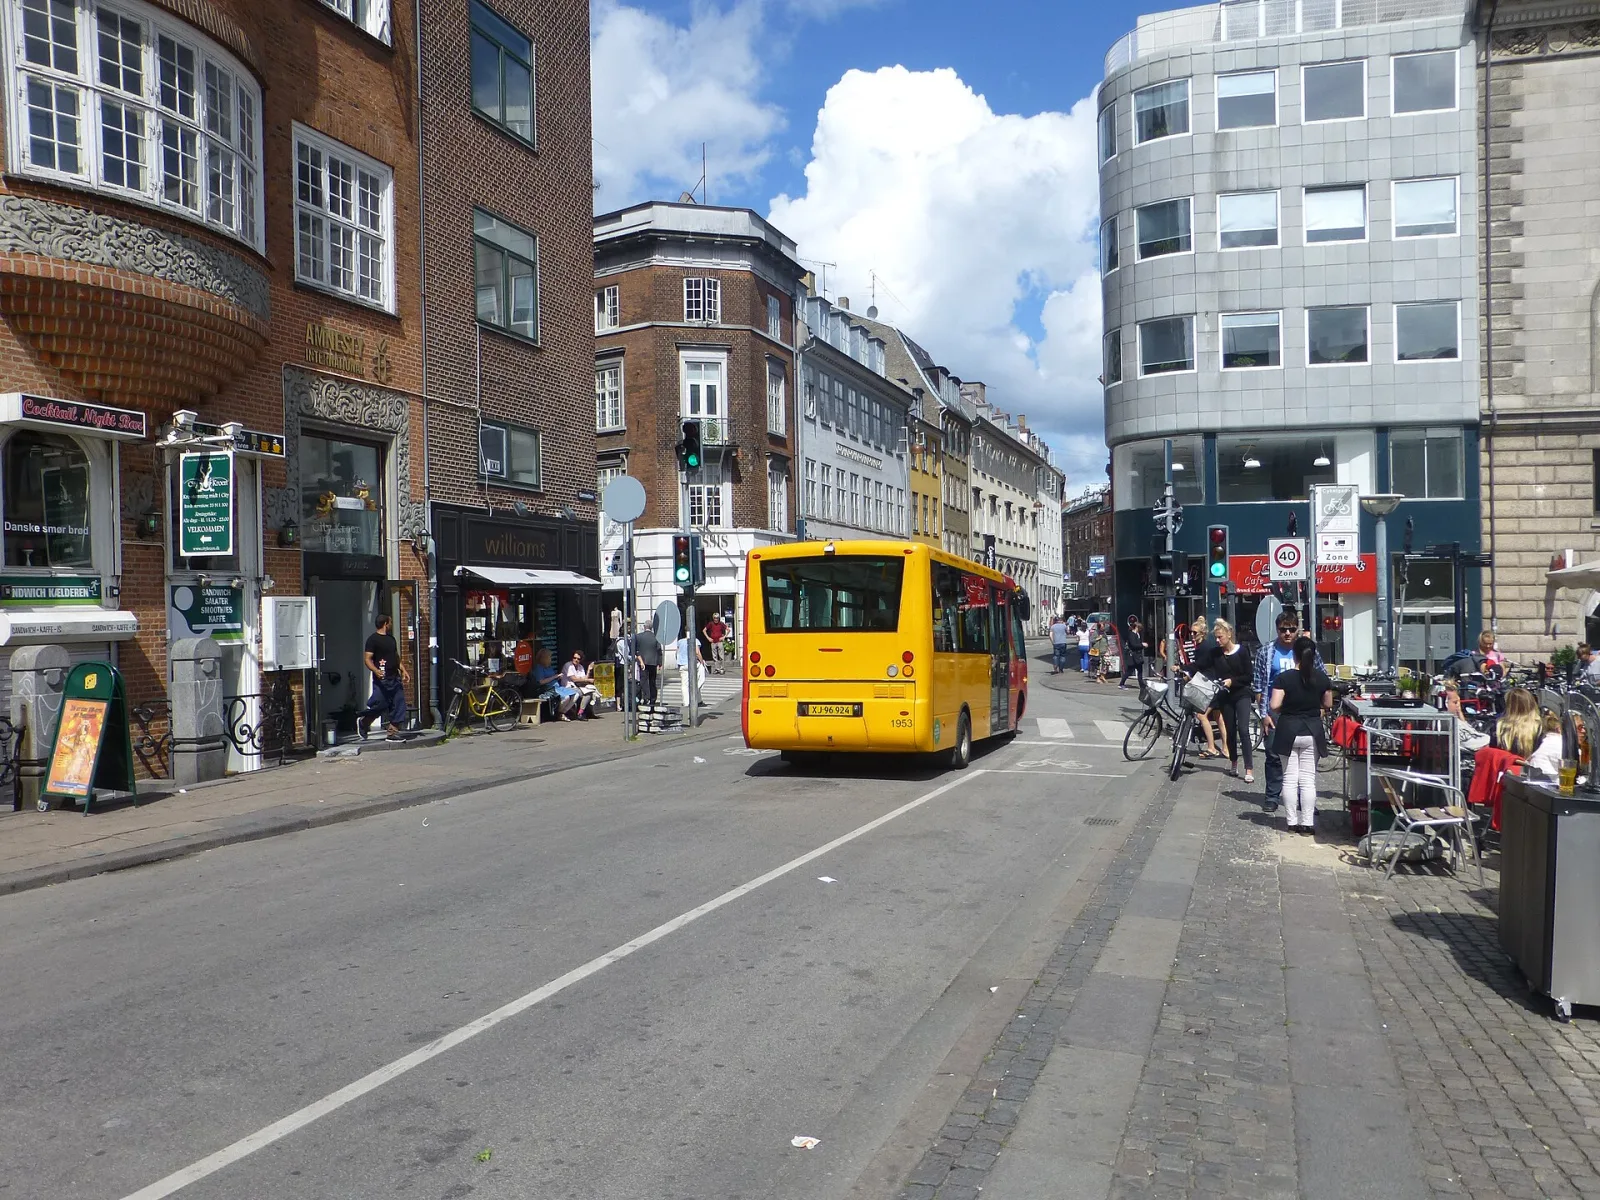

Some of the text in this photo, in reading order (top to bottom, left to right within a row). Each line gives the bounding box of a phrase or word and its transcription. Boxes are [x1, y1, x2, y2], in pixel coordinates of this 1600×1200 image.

[305, 321, 365, 359] AMNESTY
[23, 399, 144, 431] Cocktail Night Bar
[4, 521, 89, 535] Danske smør brød
[485, 532, 546, 558] williams
[1278, 550, 1296, 561] 40
[1325, 553, 1349, 561] Zone
[1334, 575, 1353, 584] Bar
[1423, 578, 1431, 586] 6
[48, 588, 89, 597] KÆLDEREN
[202, 588, 231, 596] SANDWICH
[205, 597, 229, 605] SALATER
[201, 606, 233, 614] SMOOTHIES
[208, 615, 226, 623] KAFFE
[836, 704, 849, 713] 924
[891, 719, 913, 728] 1953
